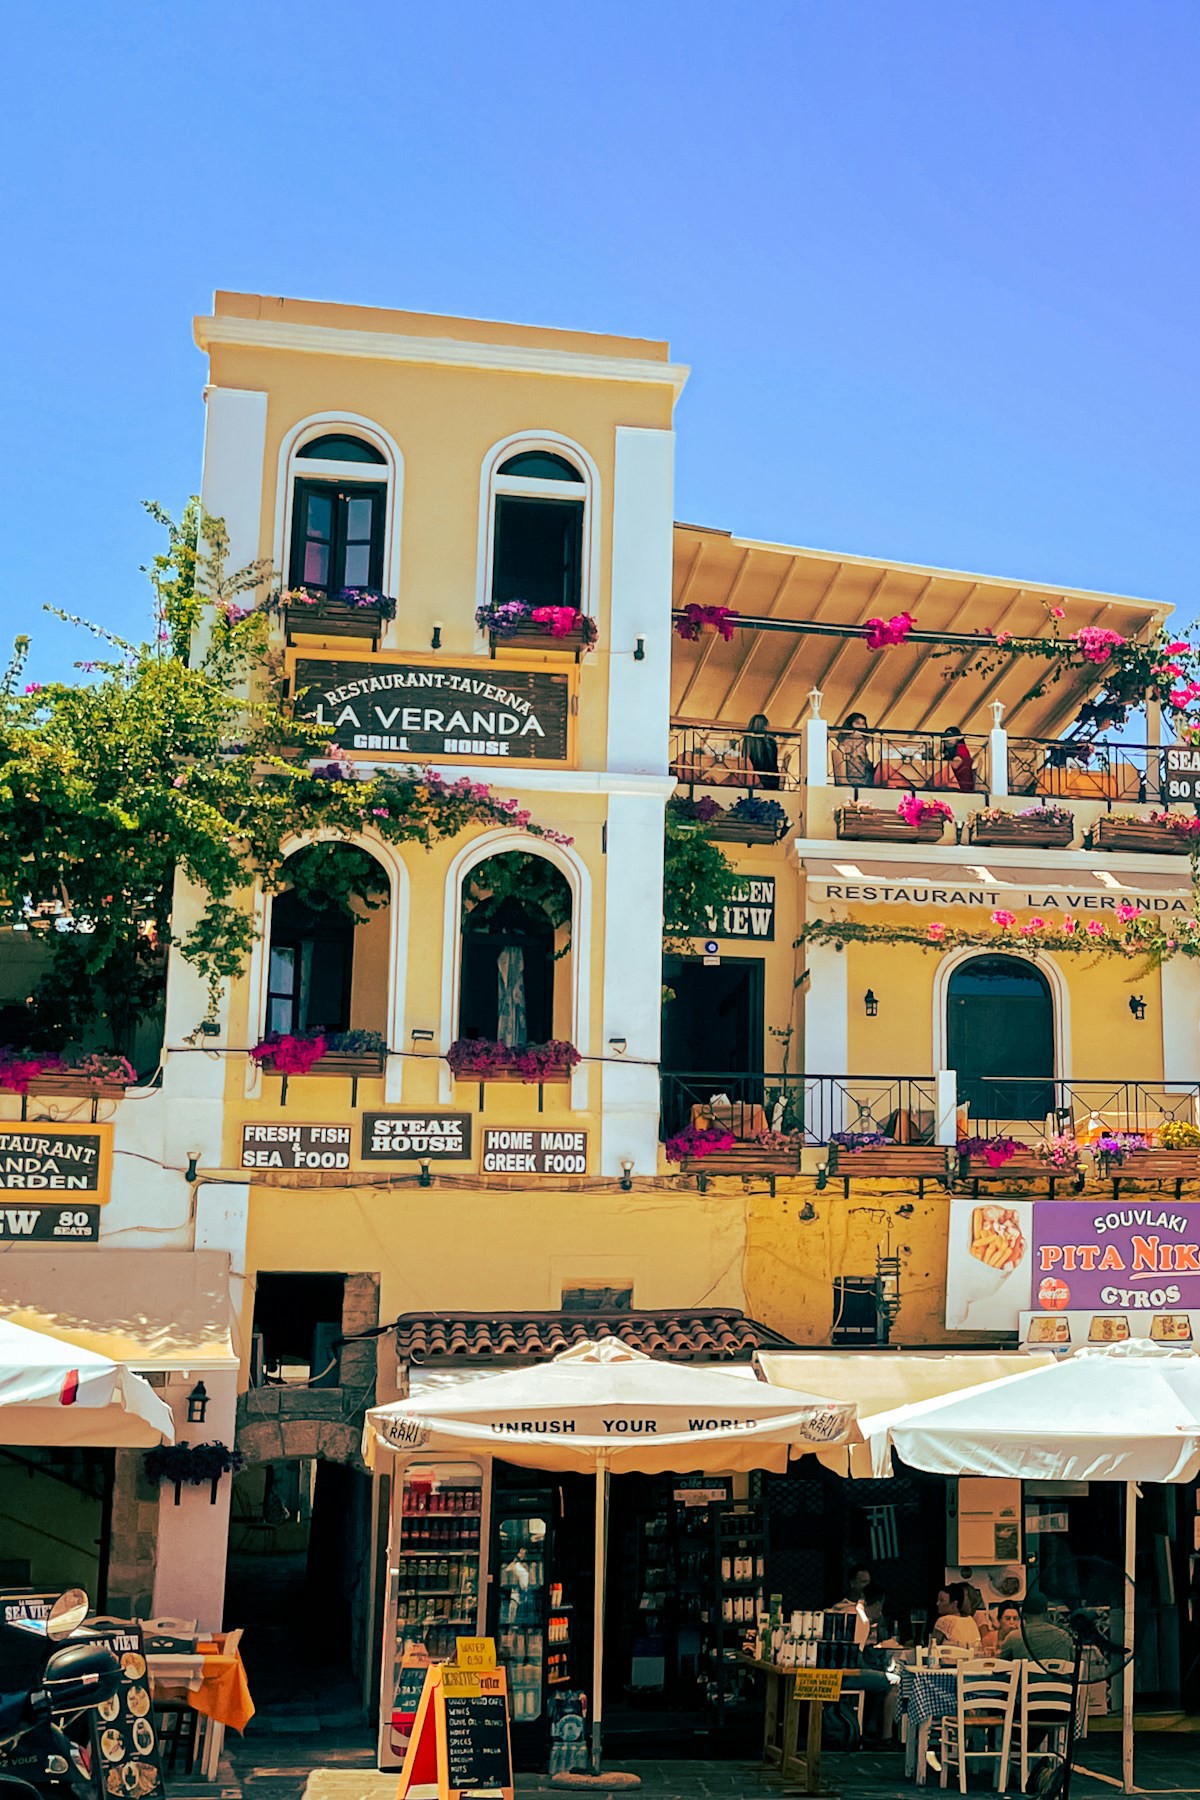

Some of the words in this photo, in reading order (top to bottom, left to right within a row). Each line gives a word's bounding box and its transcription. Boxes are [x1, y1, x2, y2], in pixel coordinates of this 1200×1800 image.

[323, 672, 532, 717] RESTAURANT-TAVERNA
[316, 703, 362, 728] LA
[375, 706, 546, 737] VERANDA
[354, 734, 409, 751] GRILL
[444, 738, 510, 756] HOUSE
[1169, 781, 1190, 797] 80
[826, 885, 1001, 906] RESTAURANT
[1028, 894, 1059, 907] LA
[1066, 895, 1187, 911] VERANDA
[244, 1126, 301, 1143] FRESH
[310, 1127, 350, 1144] FISH
[373, 1119, 463, 1135] STEAK
[291, 1142, 302, 1152] &
[370, 1136, 463, 1152] HOUSE
[488, 1131, 535, 1150] HOME
[541, 1132, 584, 1151] MADE
[0, 1157, 60, 1174] NDA
[242, 1150, 283, 1168] SEA
[295, 1152, 350, 1169] FOOD
[484, 1153, 536, 1172] GREEK
[544, 1154, 586, 1174] FOOD
[0, 1209, 41, 1235] W
[58, 1211, 89, 1227] 80
[1093, 1209, 1188, 1234] SOUVLAKI
[53, 1226, 92, 1236] SEATS
[1038, 1244, 1126, 1271] PITA
[1101, 1284, 1181, 1309] GYROS
[394, 1416, 421, 1431] YENI
[491, 1419, 575, 1434] UNRUSH
[602, 1419, 657, 1433] YOUR
[688, 1418, 758, 1432] WORLD
[808, 1418, 833, 1438] RAKI
[814, 1410, 838, 1428] YENI
[389, 1426, 420, 1443] RAKI
[4, 1605, 27, 1621] SEA
[112, 1635, 139, 1651] VIEW
